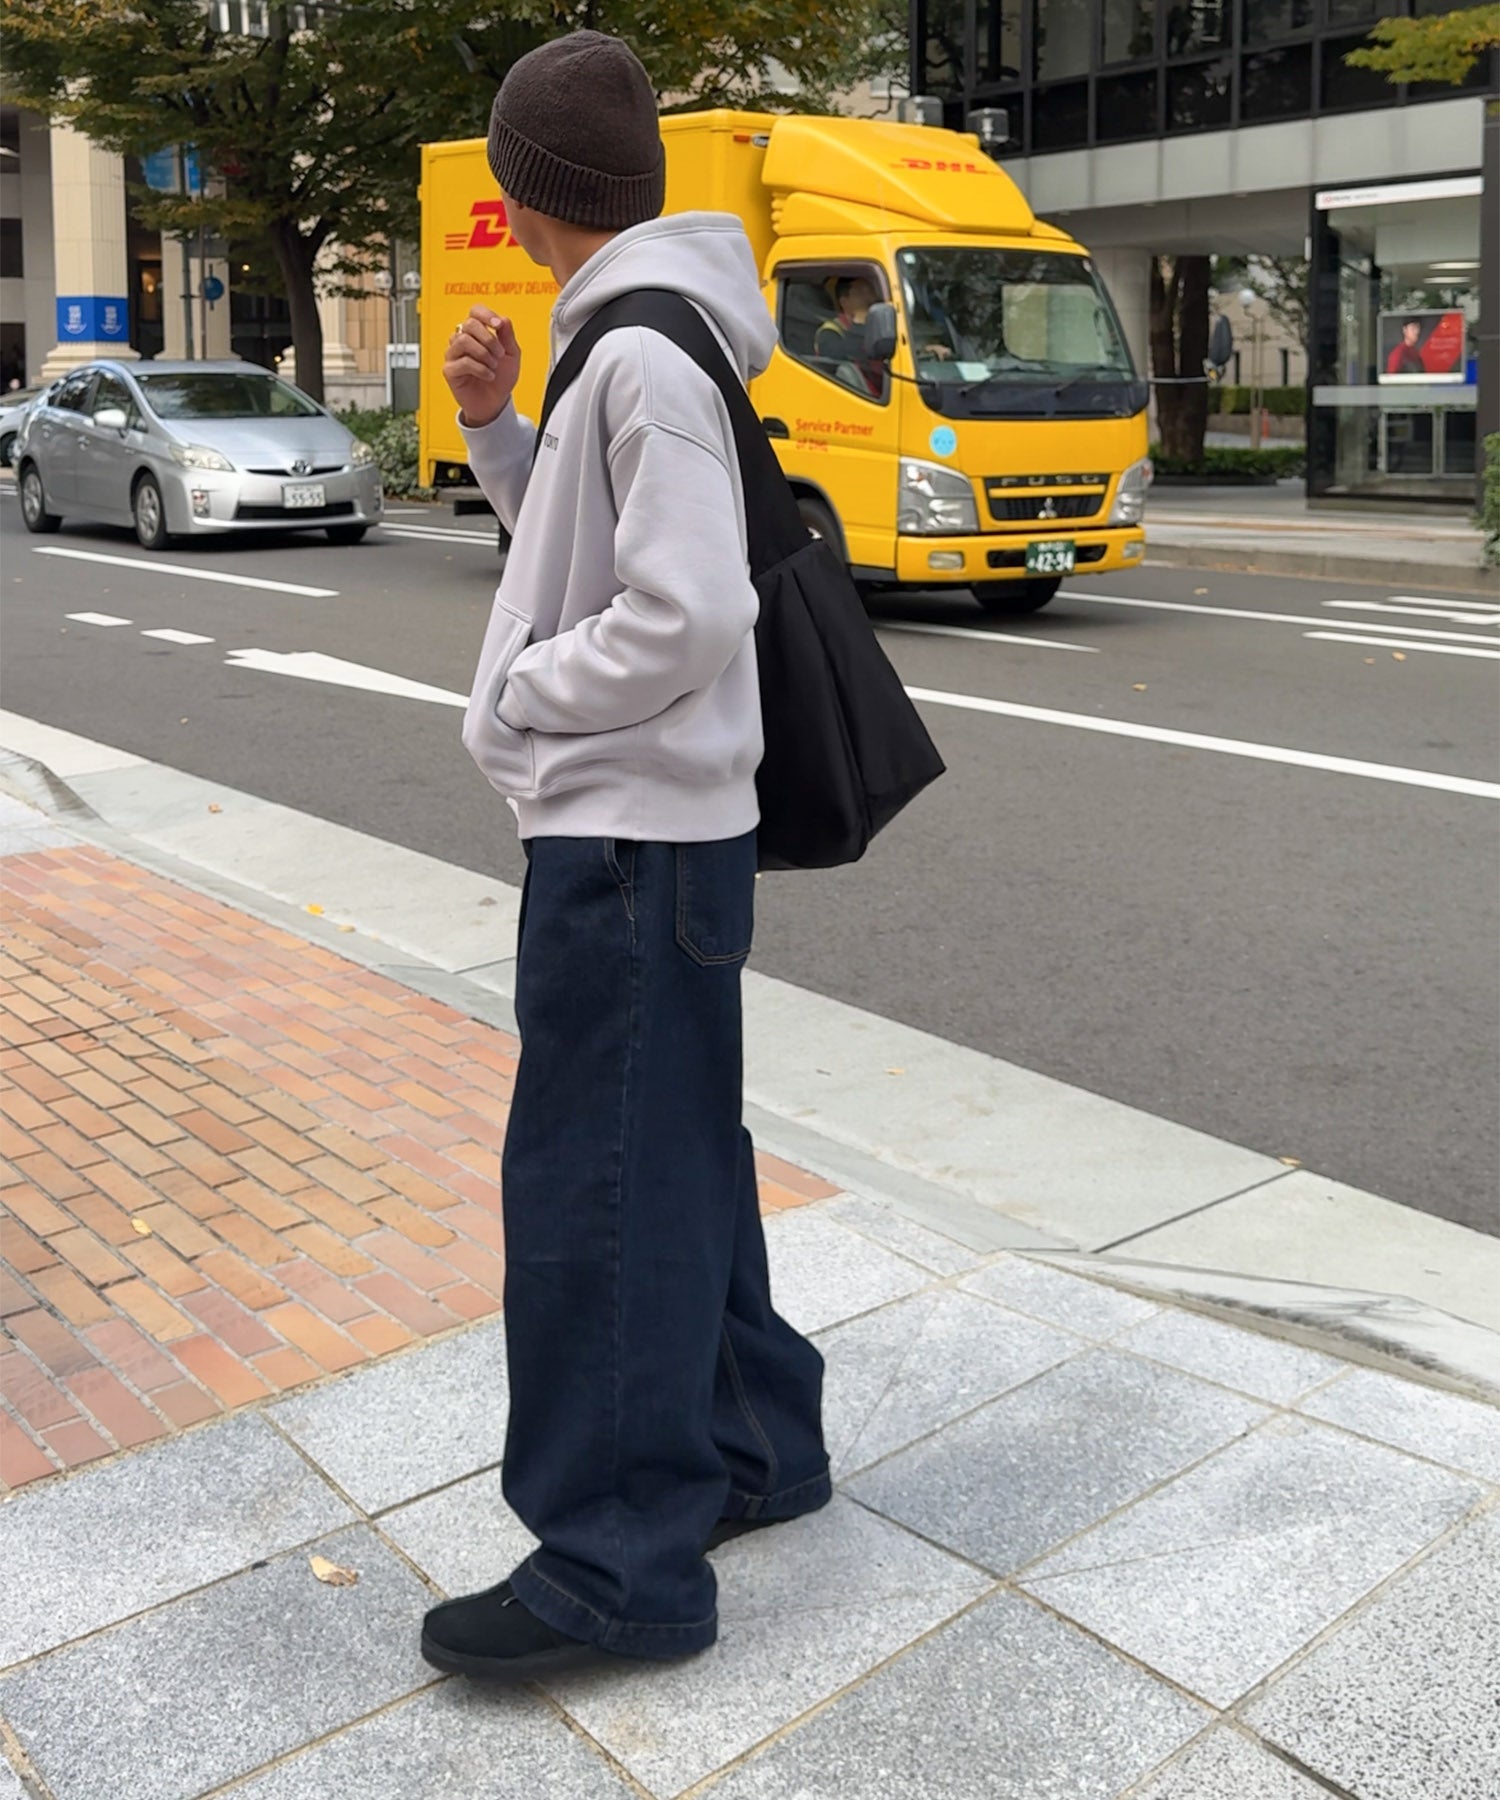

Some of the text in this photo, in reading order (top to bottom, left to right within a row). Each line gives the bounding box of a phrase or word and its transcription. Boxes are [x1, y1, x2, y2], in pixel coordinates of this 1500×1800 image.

[900, 158, 988, 175] DHL
[494, 281, 523, 295] SIMPLY
[795, 418, 873, 436] Service Partner
[1001, 475, 1099, 486] FUSO
